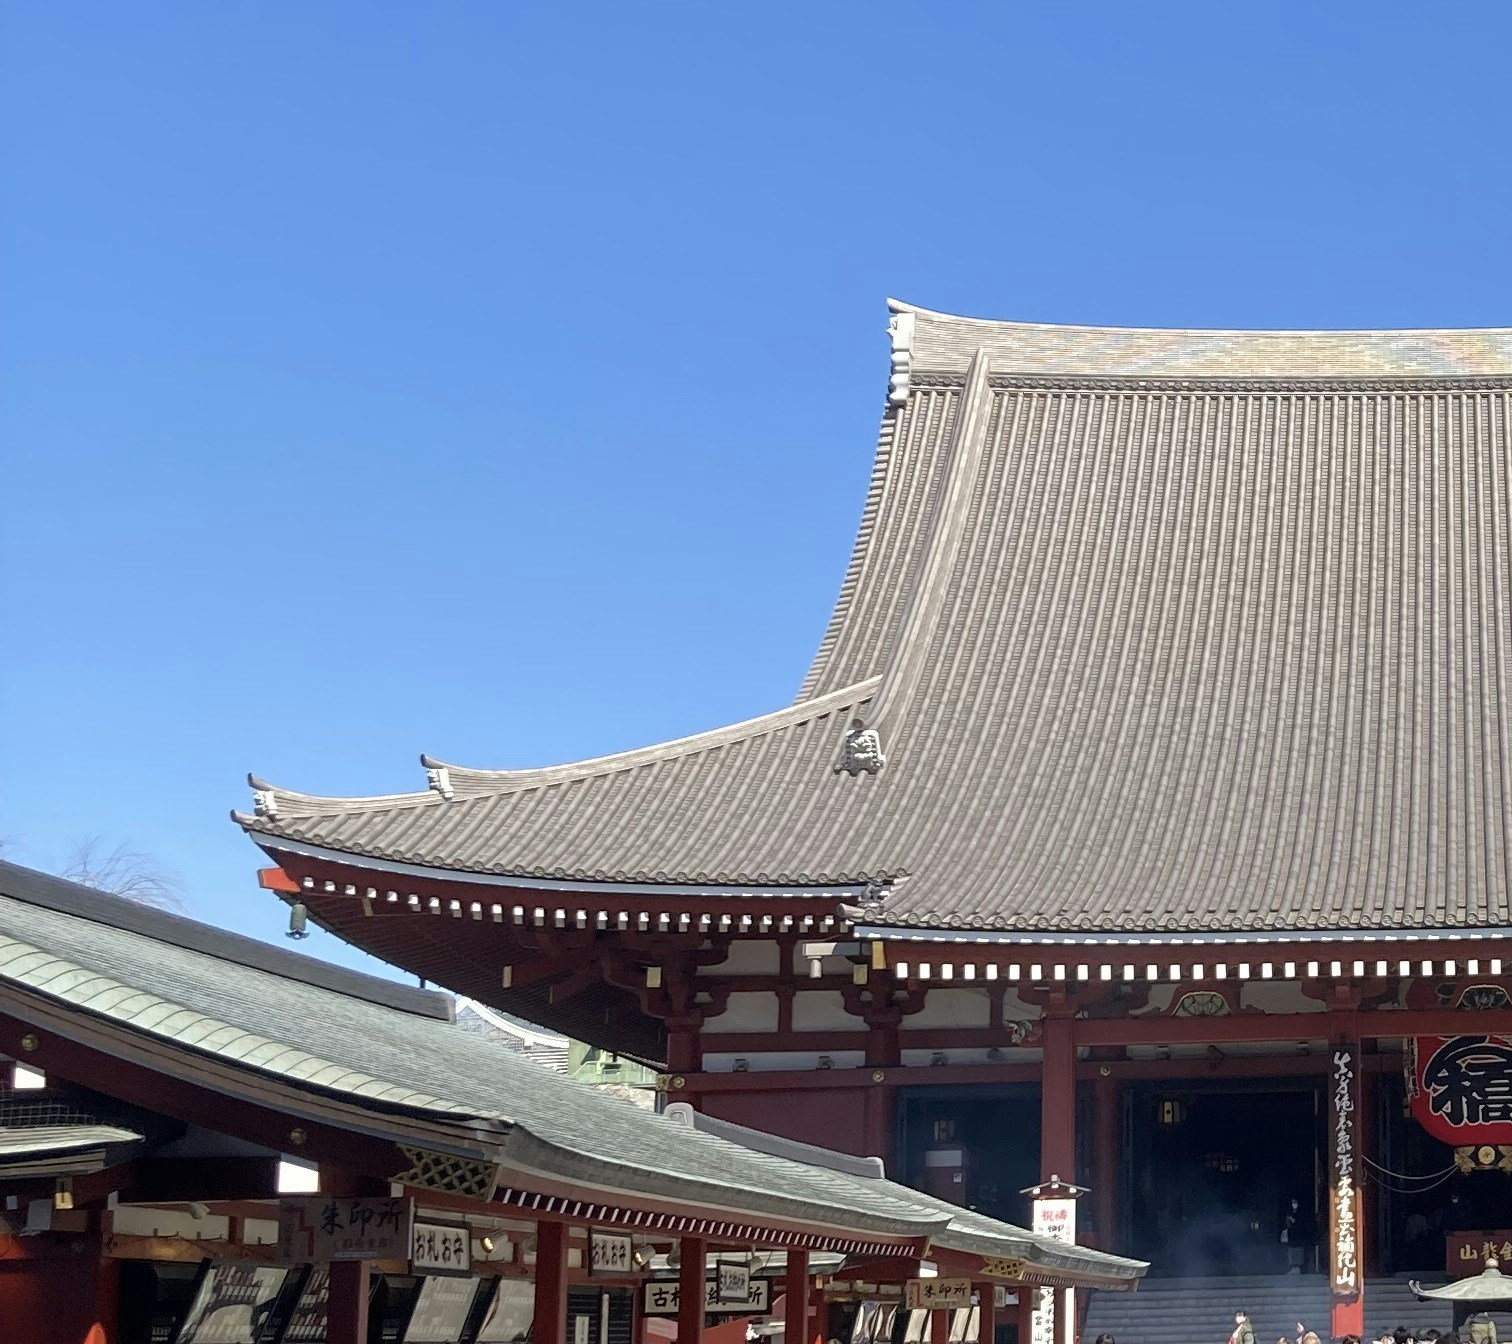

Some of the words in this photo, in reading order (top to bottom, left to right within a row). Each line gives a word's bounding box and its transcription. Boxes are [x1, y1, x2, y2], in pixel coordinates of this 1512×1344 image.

[320, 1200, 404, 1237] 朱印所
[416, 1230, 464, 1266] お札お守
[924, 1283, 967, 1299] 朱印所
